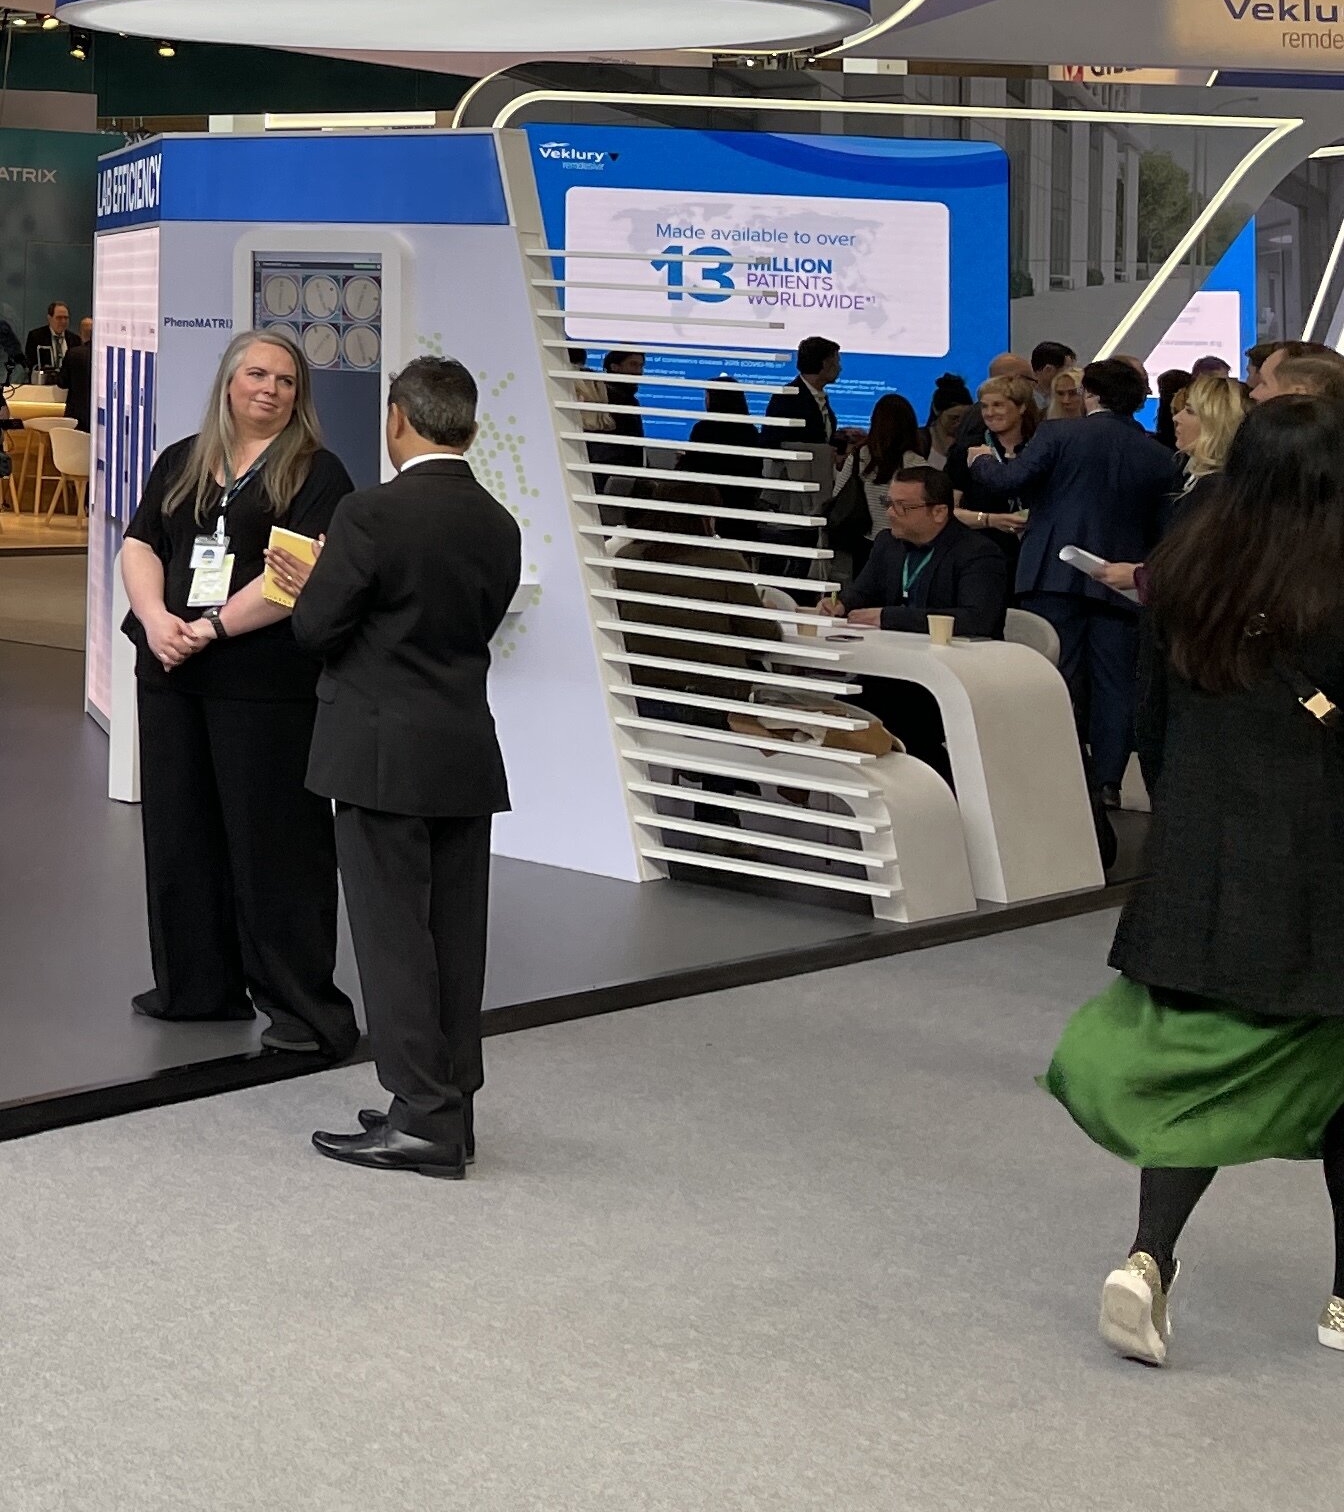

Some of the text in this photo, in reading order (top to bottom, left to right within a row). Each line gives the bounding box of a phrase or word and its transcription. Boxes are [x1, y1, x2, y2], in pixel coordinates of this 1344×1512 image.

[97, 153, 162, 217] LAB EFFICIENCY
[656, 223, 857, 246] Made available to over
[651, 245, 735, 303] 13
[747, 273, 833, 290] PATIENTS
